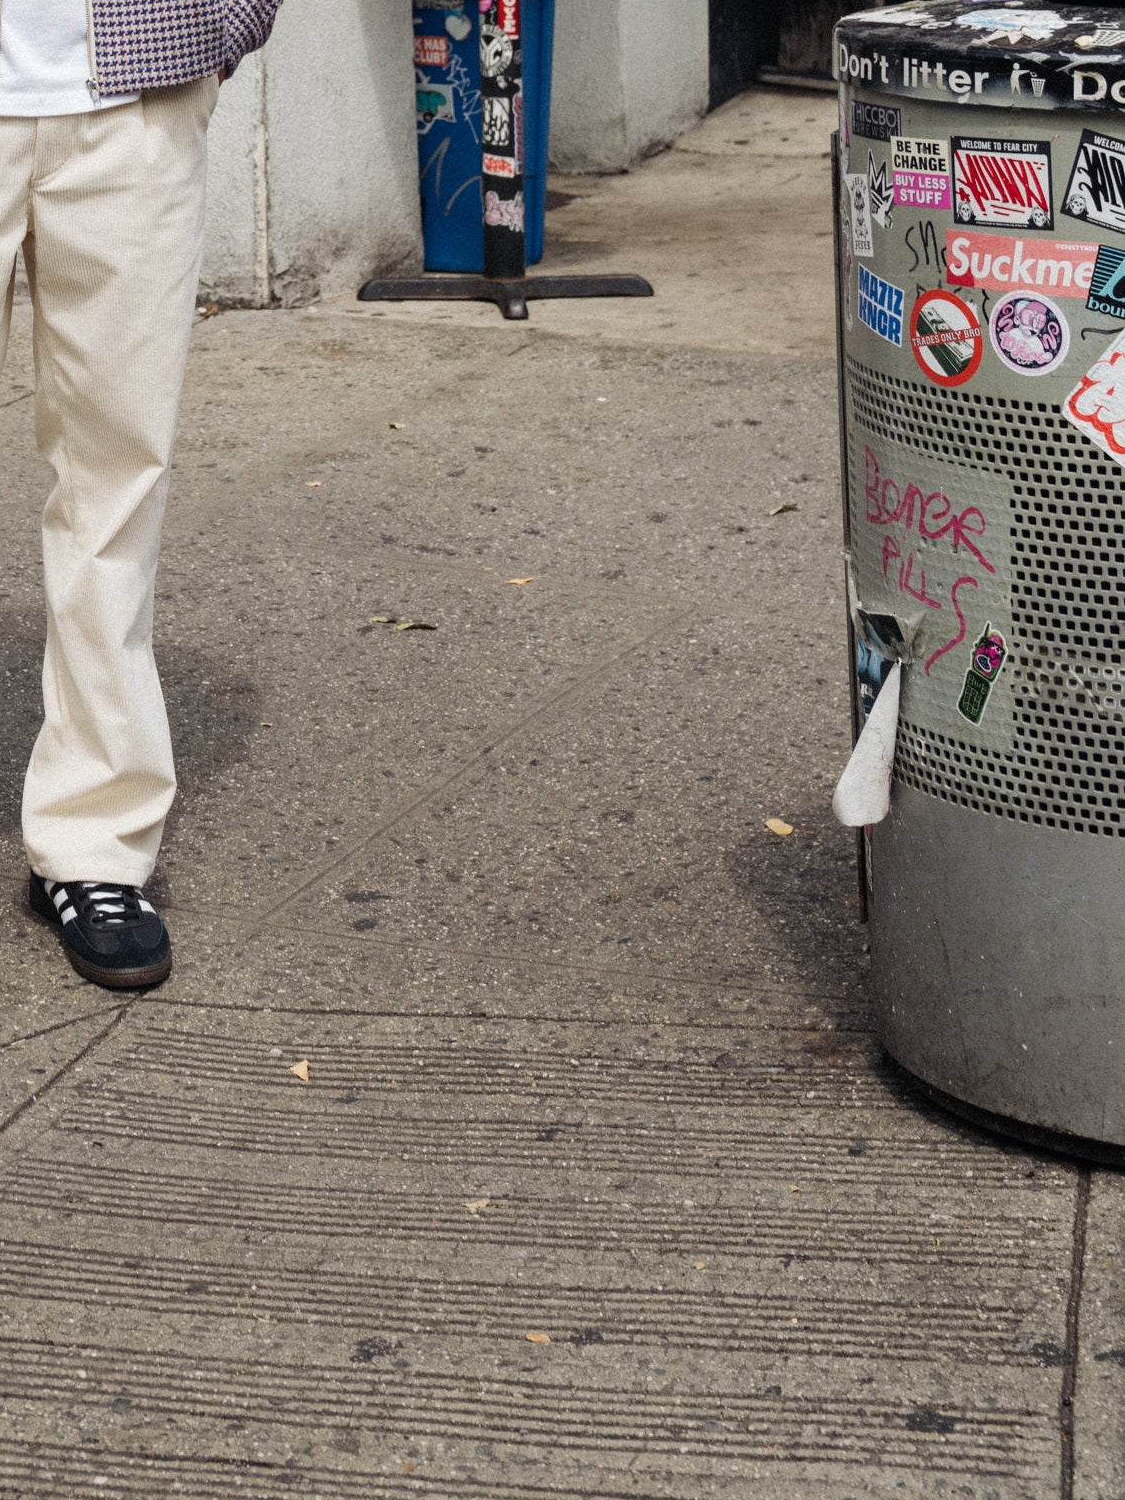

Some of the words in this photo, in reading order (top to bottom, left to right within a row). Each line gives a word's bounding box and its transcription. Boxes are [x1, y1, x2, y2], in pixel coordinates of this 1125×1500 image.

[839, 43, 889, 84] Don't
[902, 56, 989, 95] litter
[896, 141, 912, 153] BE
[915, 142, 940, 155] THE
[960, 139, 991, 150] WELCOME
[993, 142, 1001, 150] TO
[1003, 142, 1020, 152] FEAR
[1022, 143, 1037, 152] CITY
[894, 154, 947, 172] CHANGE
[895, 174, 915, 187] BUY
[918, 176, 947, 190] LESS
[900, 189, 942, 205] STUFF
[949, 237, 1095, 289] Suckme
[912, 334, 939, 347] TRADES
[941, 331, 961, 342] ONLY
[964, 328, 981, 339] BRO
